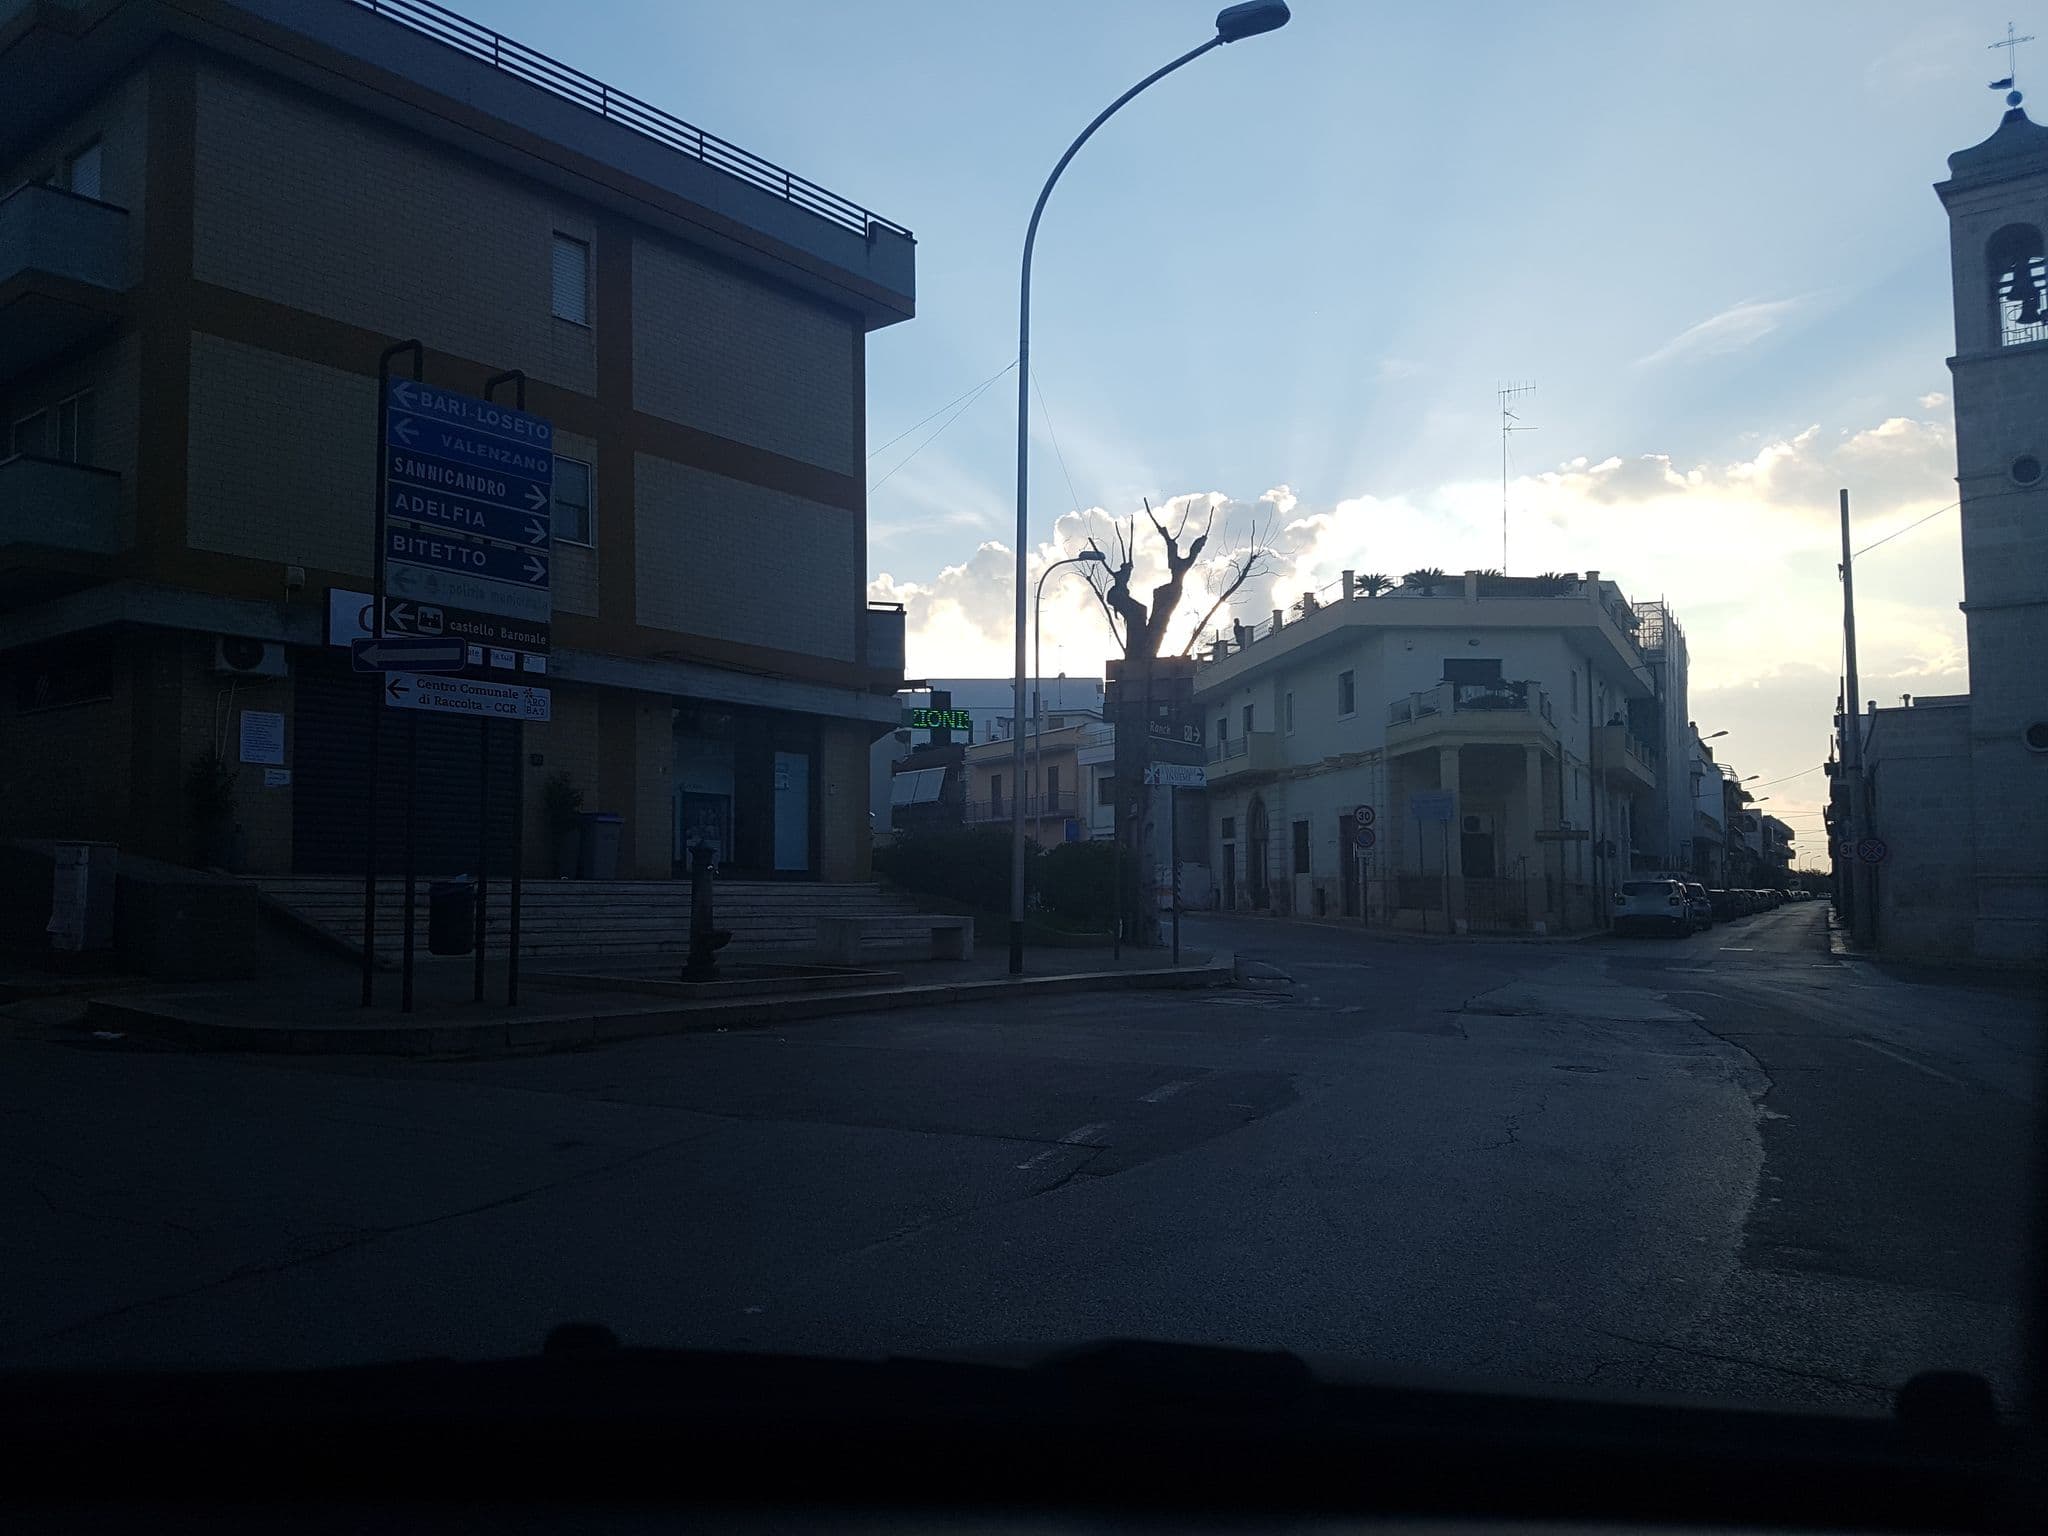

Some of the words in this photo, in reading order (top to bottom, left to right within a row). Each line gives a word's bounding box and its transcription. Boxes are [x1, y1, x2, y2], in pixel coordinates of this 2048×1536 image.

[440, 434, 548, 472] VALENZANO
[394, 456, 506, 497] SANNICANDRO
[395, 493, 486, 527] ADELFIA
[392, 534, 487, 567] BITETTO
[450, 621, 494, 637] castello
[501, 629, 546, 645] Baronale
[416, 678, 457, 693] Centro
[461, 683, 519, 699] Comunale
[418, 694, 430, 705] di
[434, 695, 482, 711] Raccolta
[494, 702, 518, 714] CCR
[1358, 811, 1371, 821] 30
